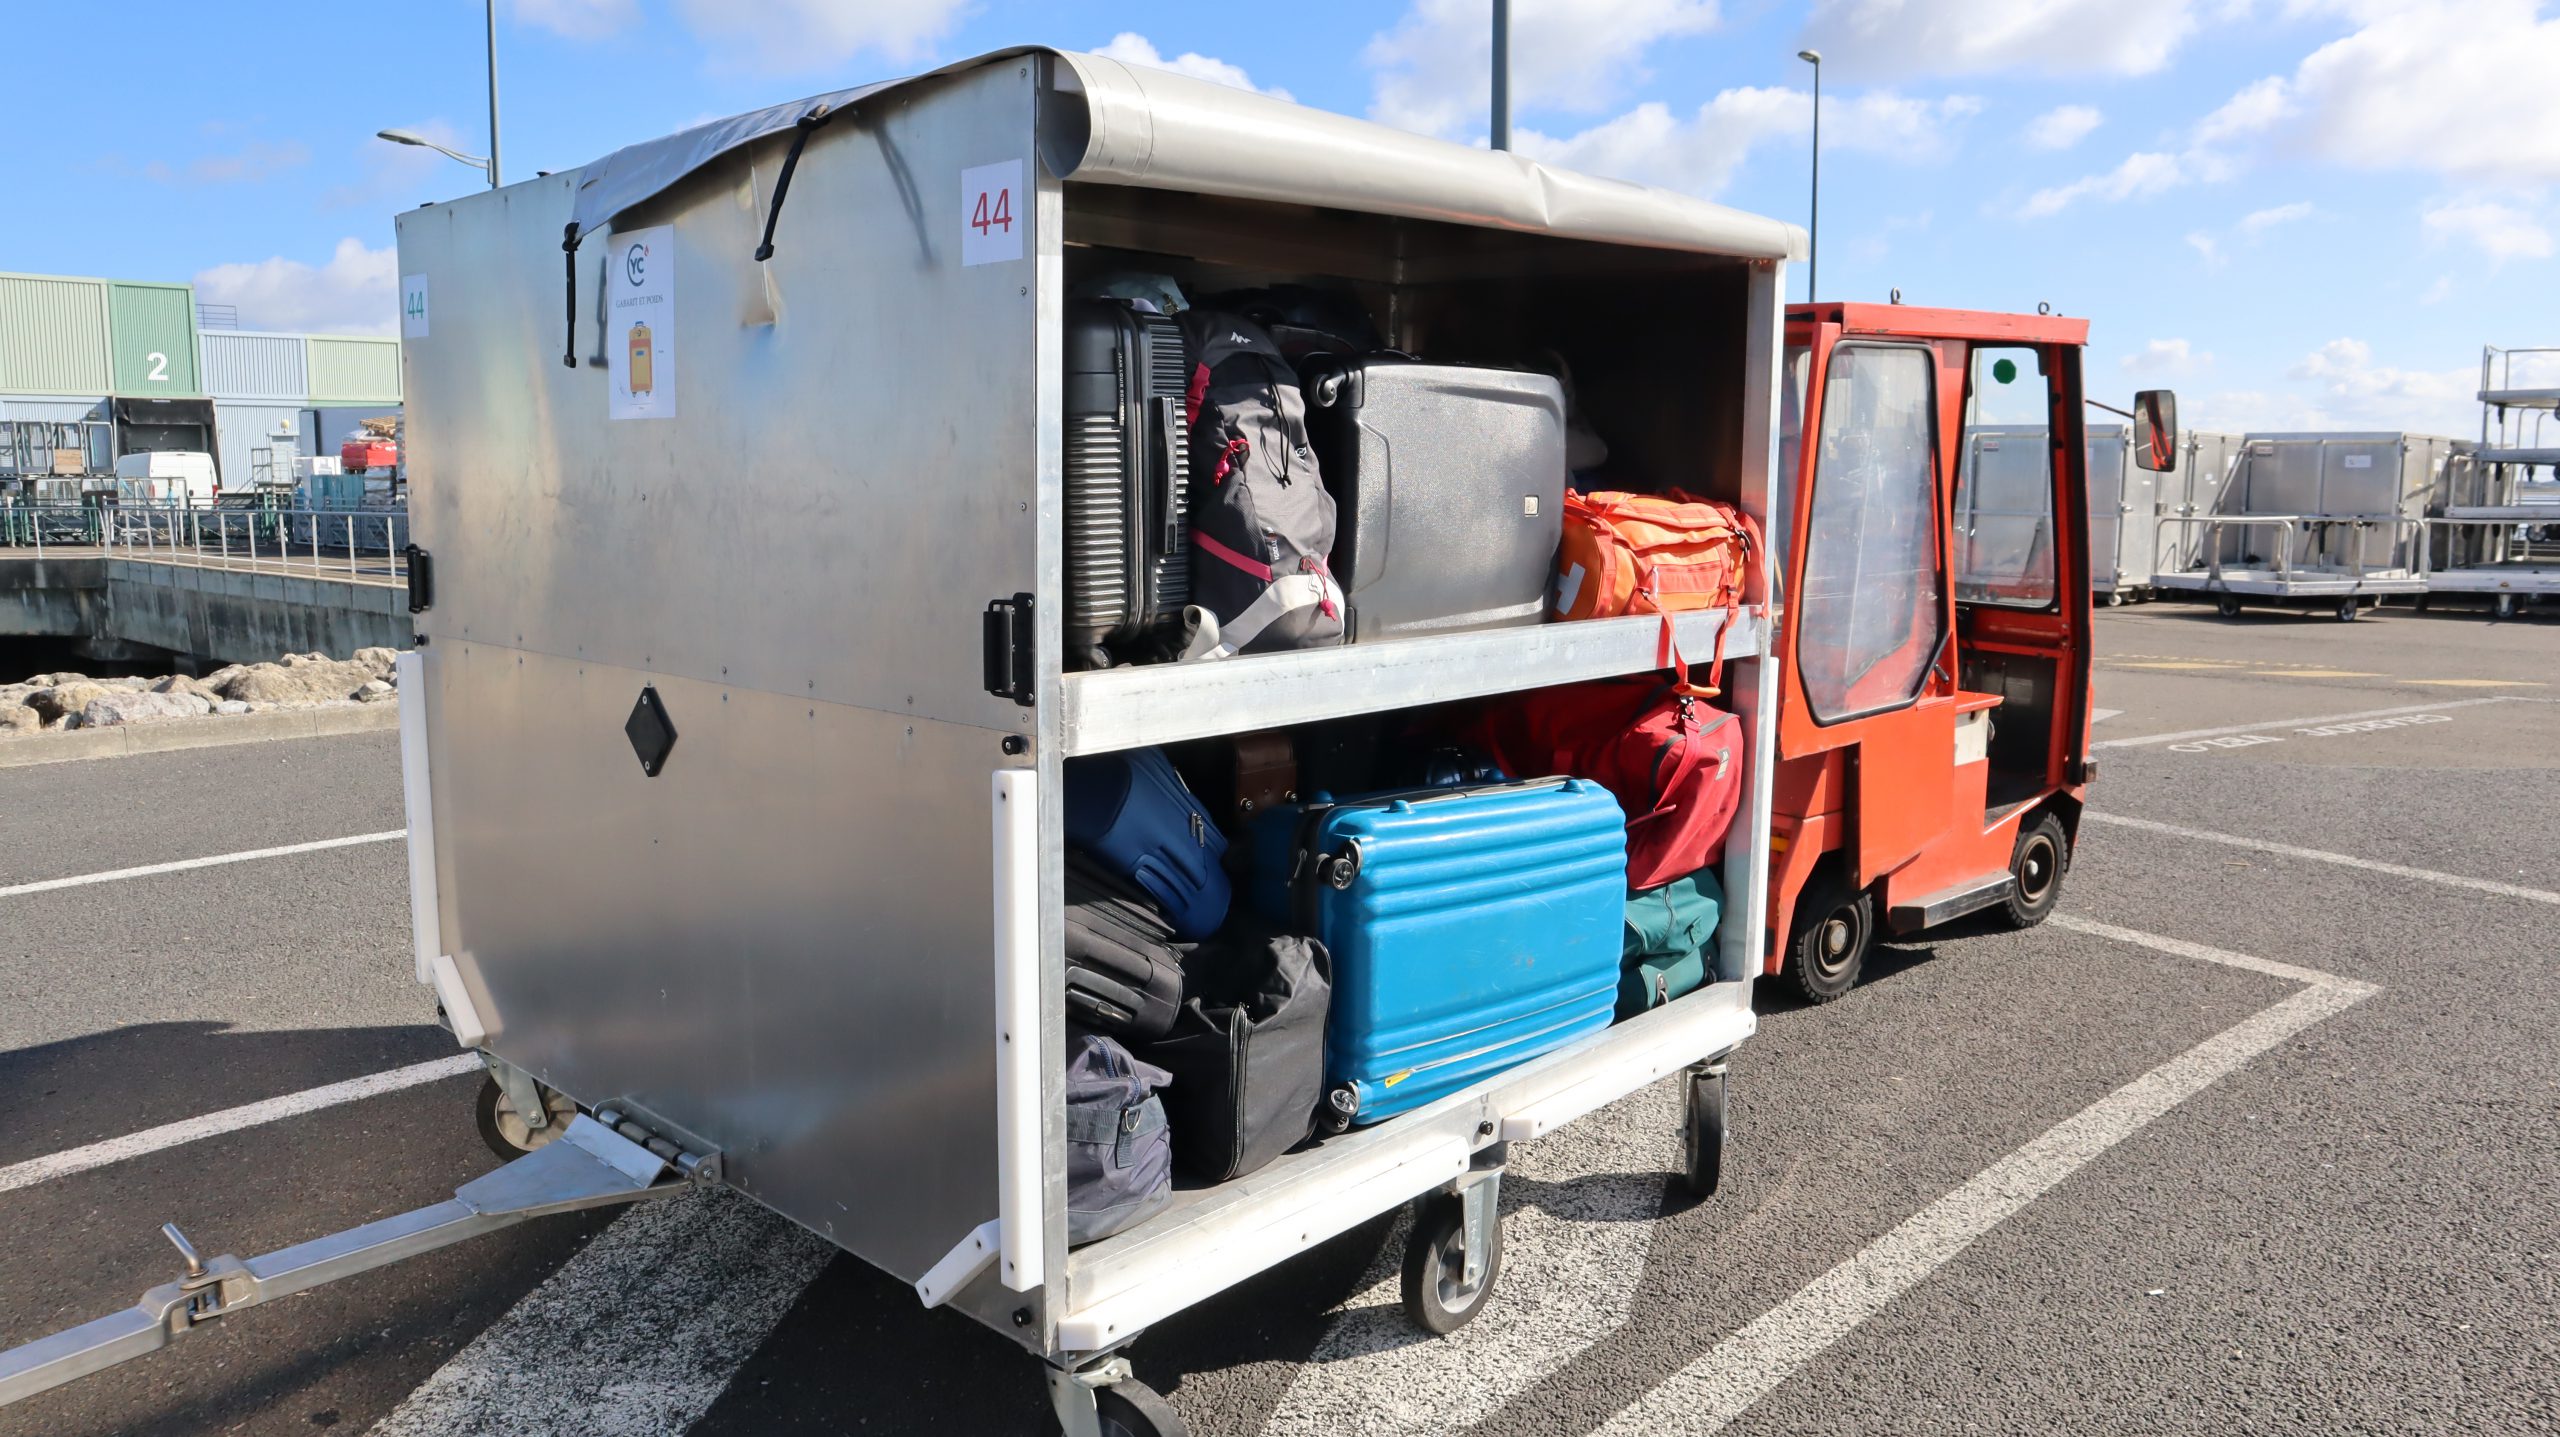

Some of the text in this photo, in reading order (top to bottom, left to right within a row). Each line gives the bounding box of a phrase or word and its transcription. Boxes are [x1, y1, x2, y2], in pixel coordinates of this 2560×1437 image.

[972, 189, 1012, 236] 44
[408, 291, 424, 320] 44
[148, 352, 168, 381] 2
